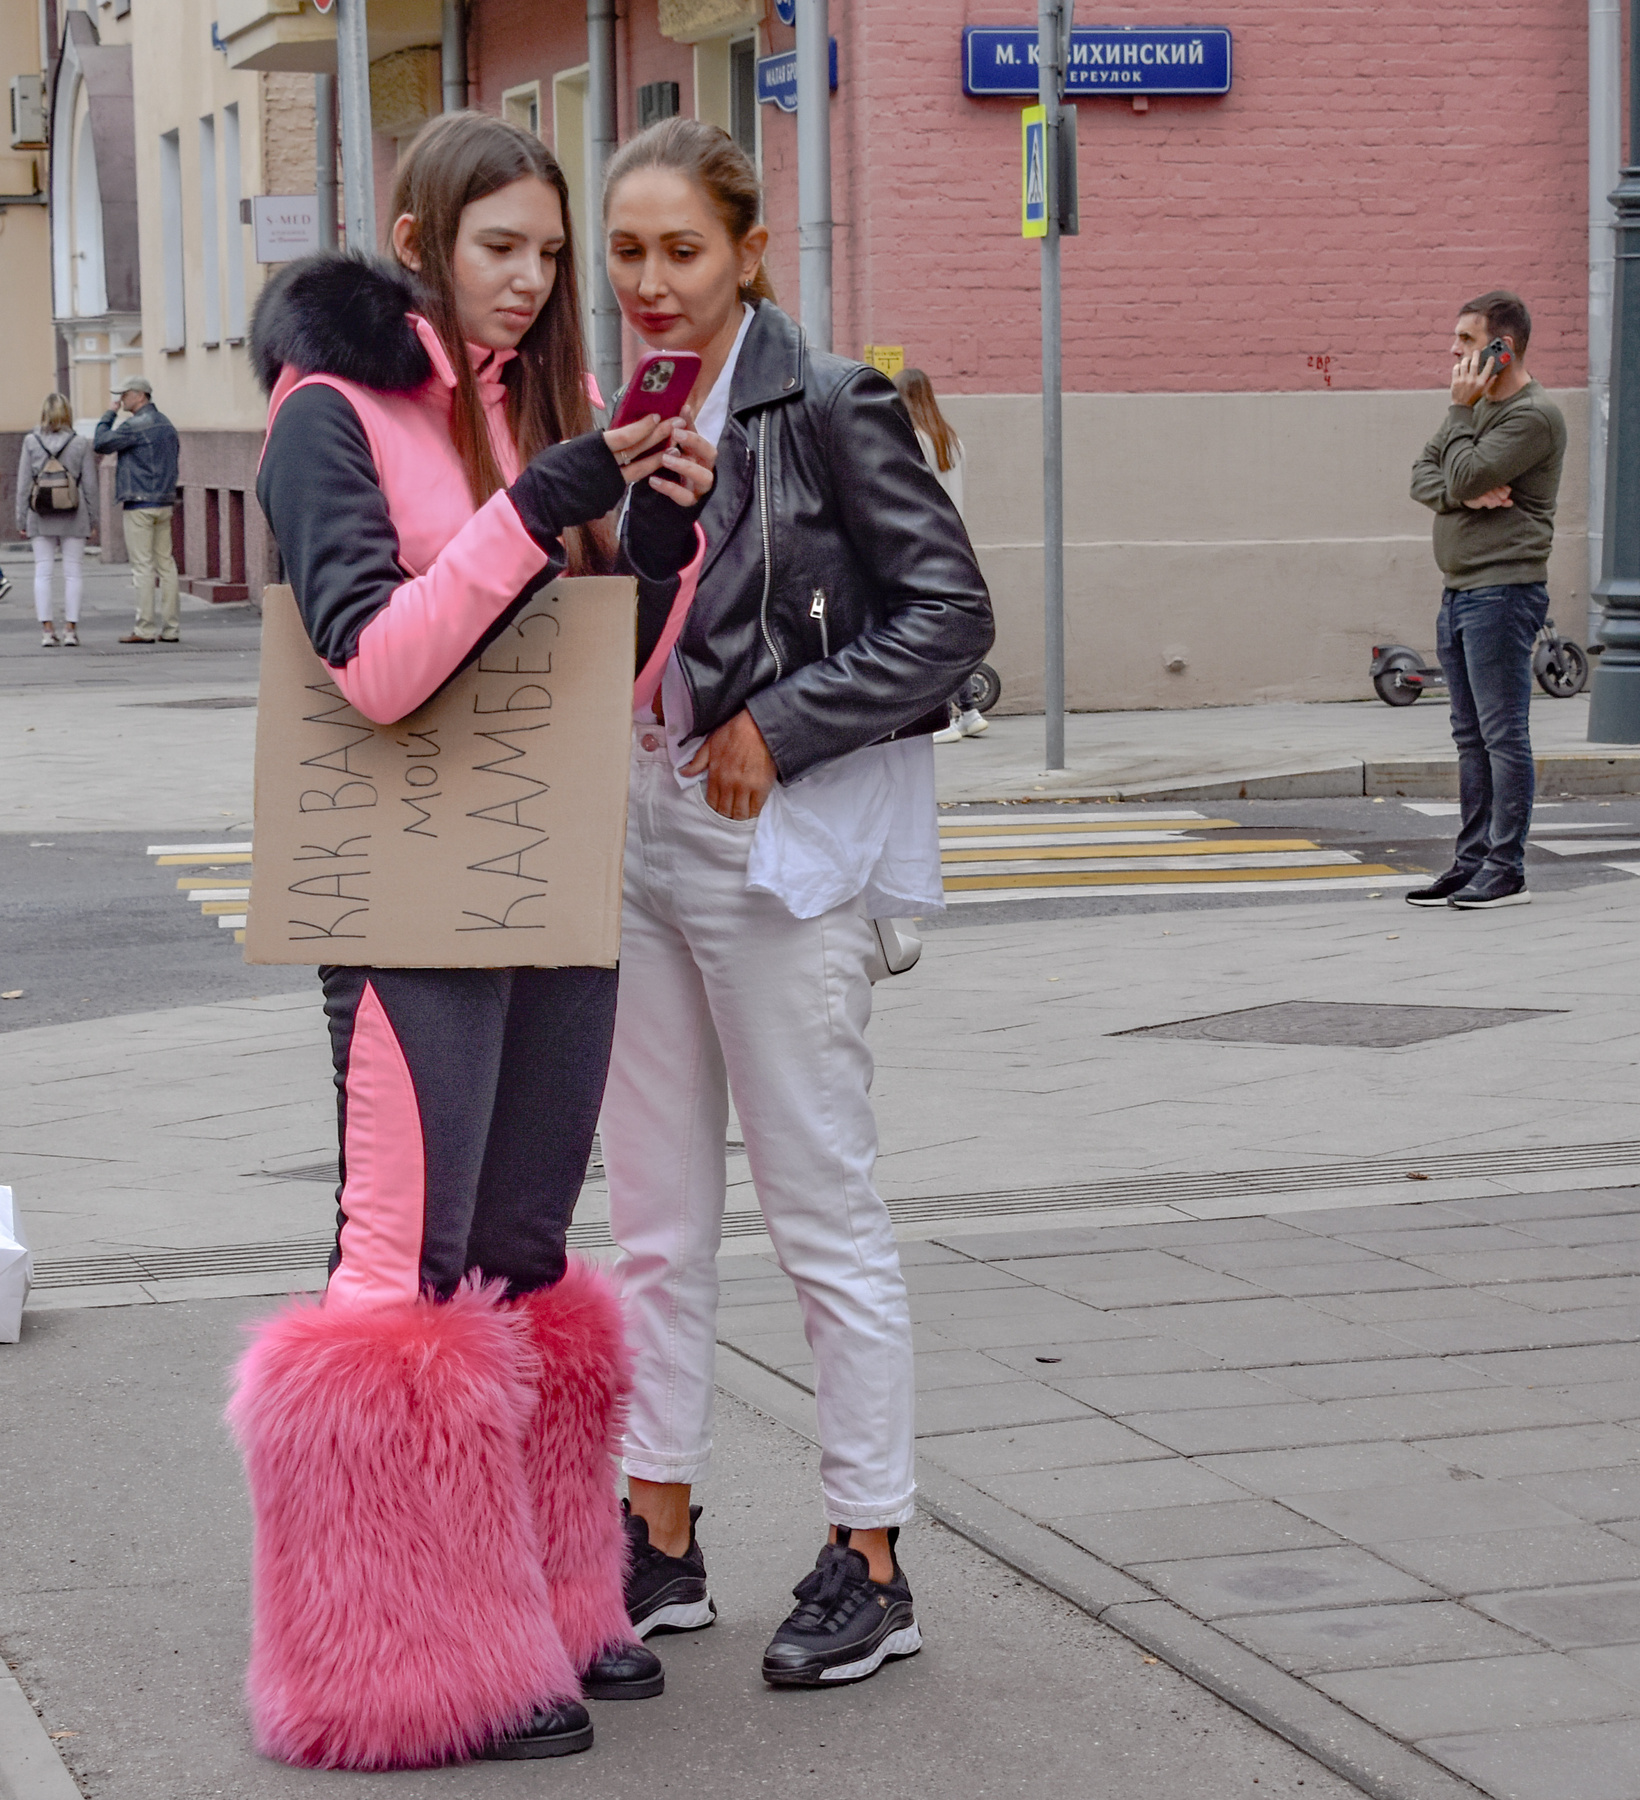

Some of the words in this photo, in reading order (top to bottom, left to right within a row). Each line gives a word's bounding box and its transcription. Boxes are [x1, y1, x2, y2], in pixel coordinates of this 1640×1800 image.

[995, 44, 1020, 65] М.
[1027, 39, 1204, 65] КИХИНСКИЙ
[1070, 71, 1143, 83] ЕРЕУЛОК
[298, 681, 379, 813] ВАМ
[396, 728, 443, 838] МОЙ
[287, 834, 373, 941] КАК
